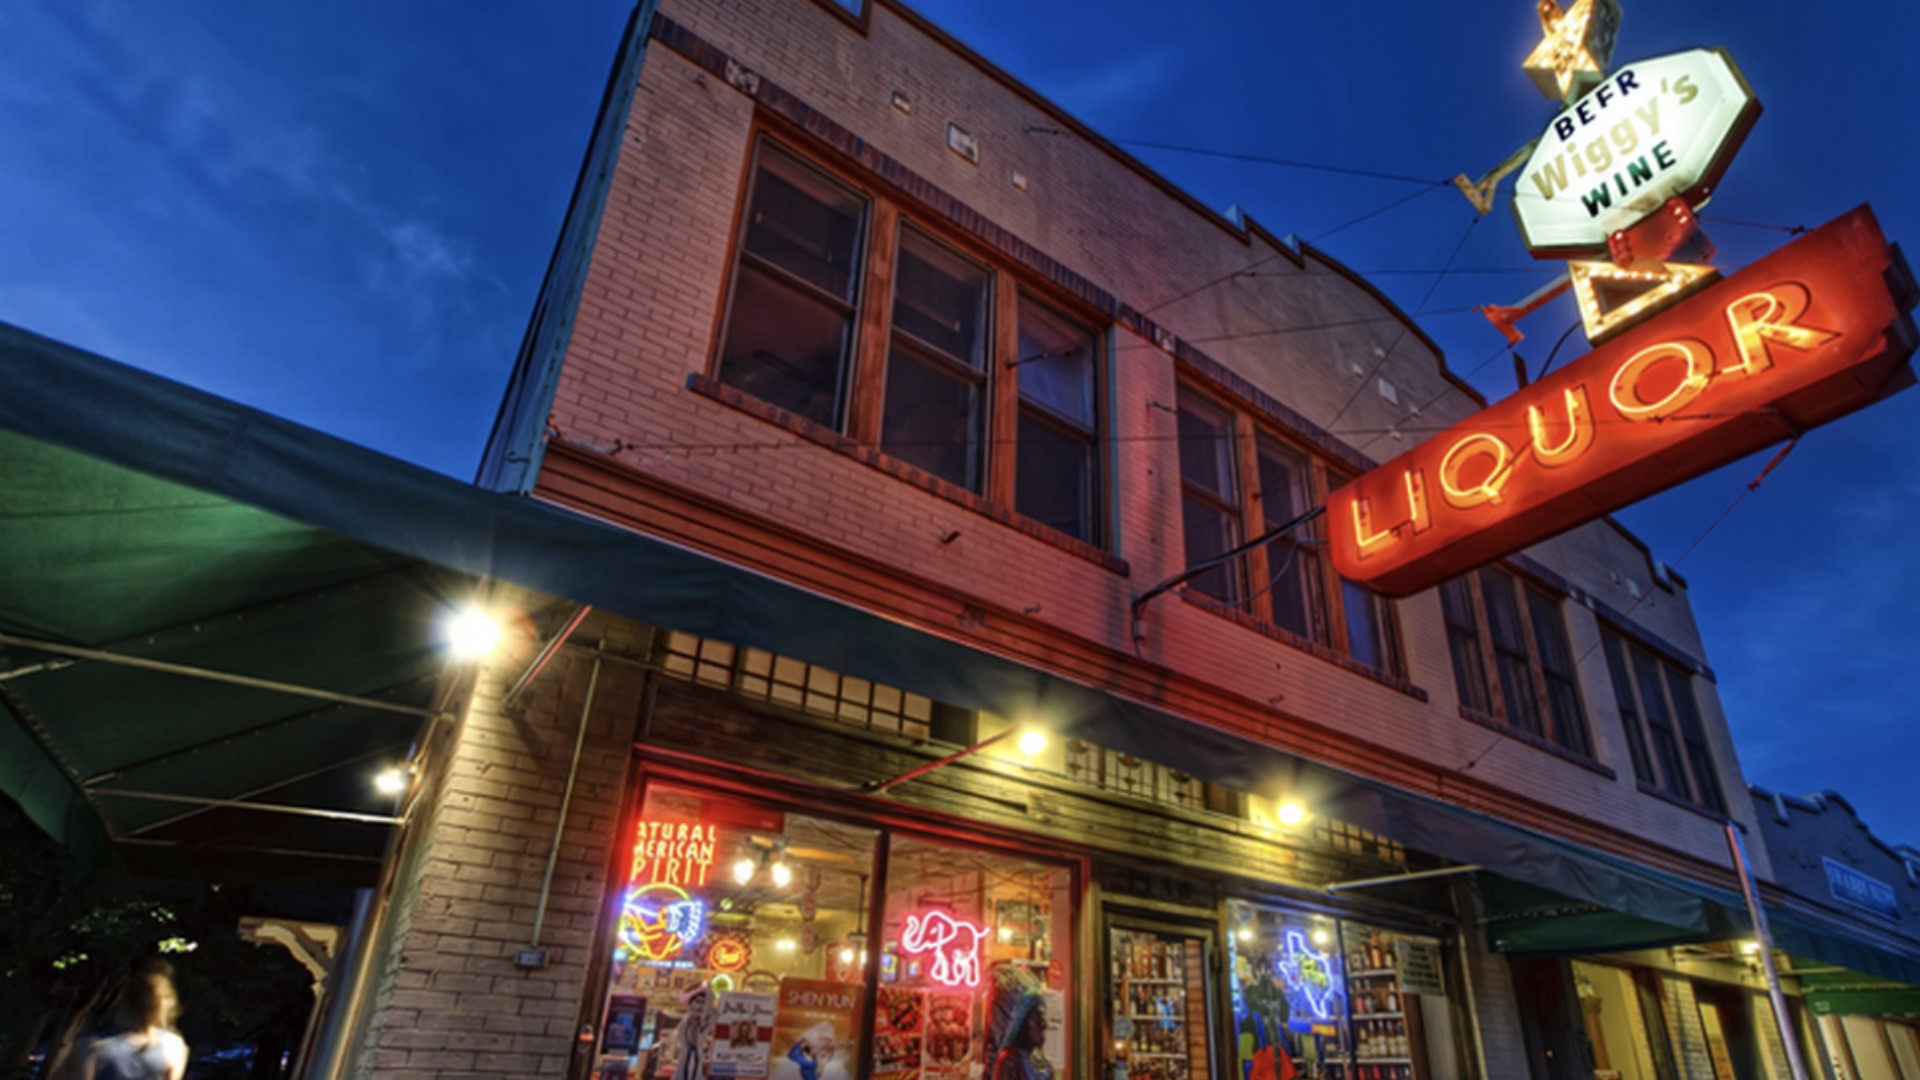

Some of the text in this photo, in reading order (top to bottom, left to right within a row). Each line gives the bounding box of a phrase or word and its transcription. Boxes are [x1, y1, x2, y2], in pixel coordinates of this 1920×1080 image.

[1530, 71, 1701, 201] Wiggy's
[1580, 140, 1678, 218] WINE
[1351, 280, 1841, 559] LIQUOR
[637, 821, 717, 842] ATURAL
[630, 857, 712, 886] PIRIT
[787, 990, 825, 1006] SHEN
[826, 993, 856, 1009] YUN
